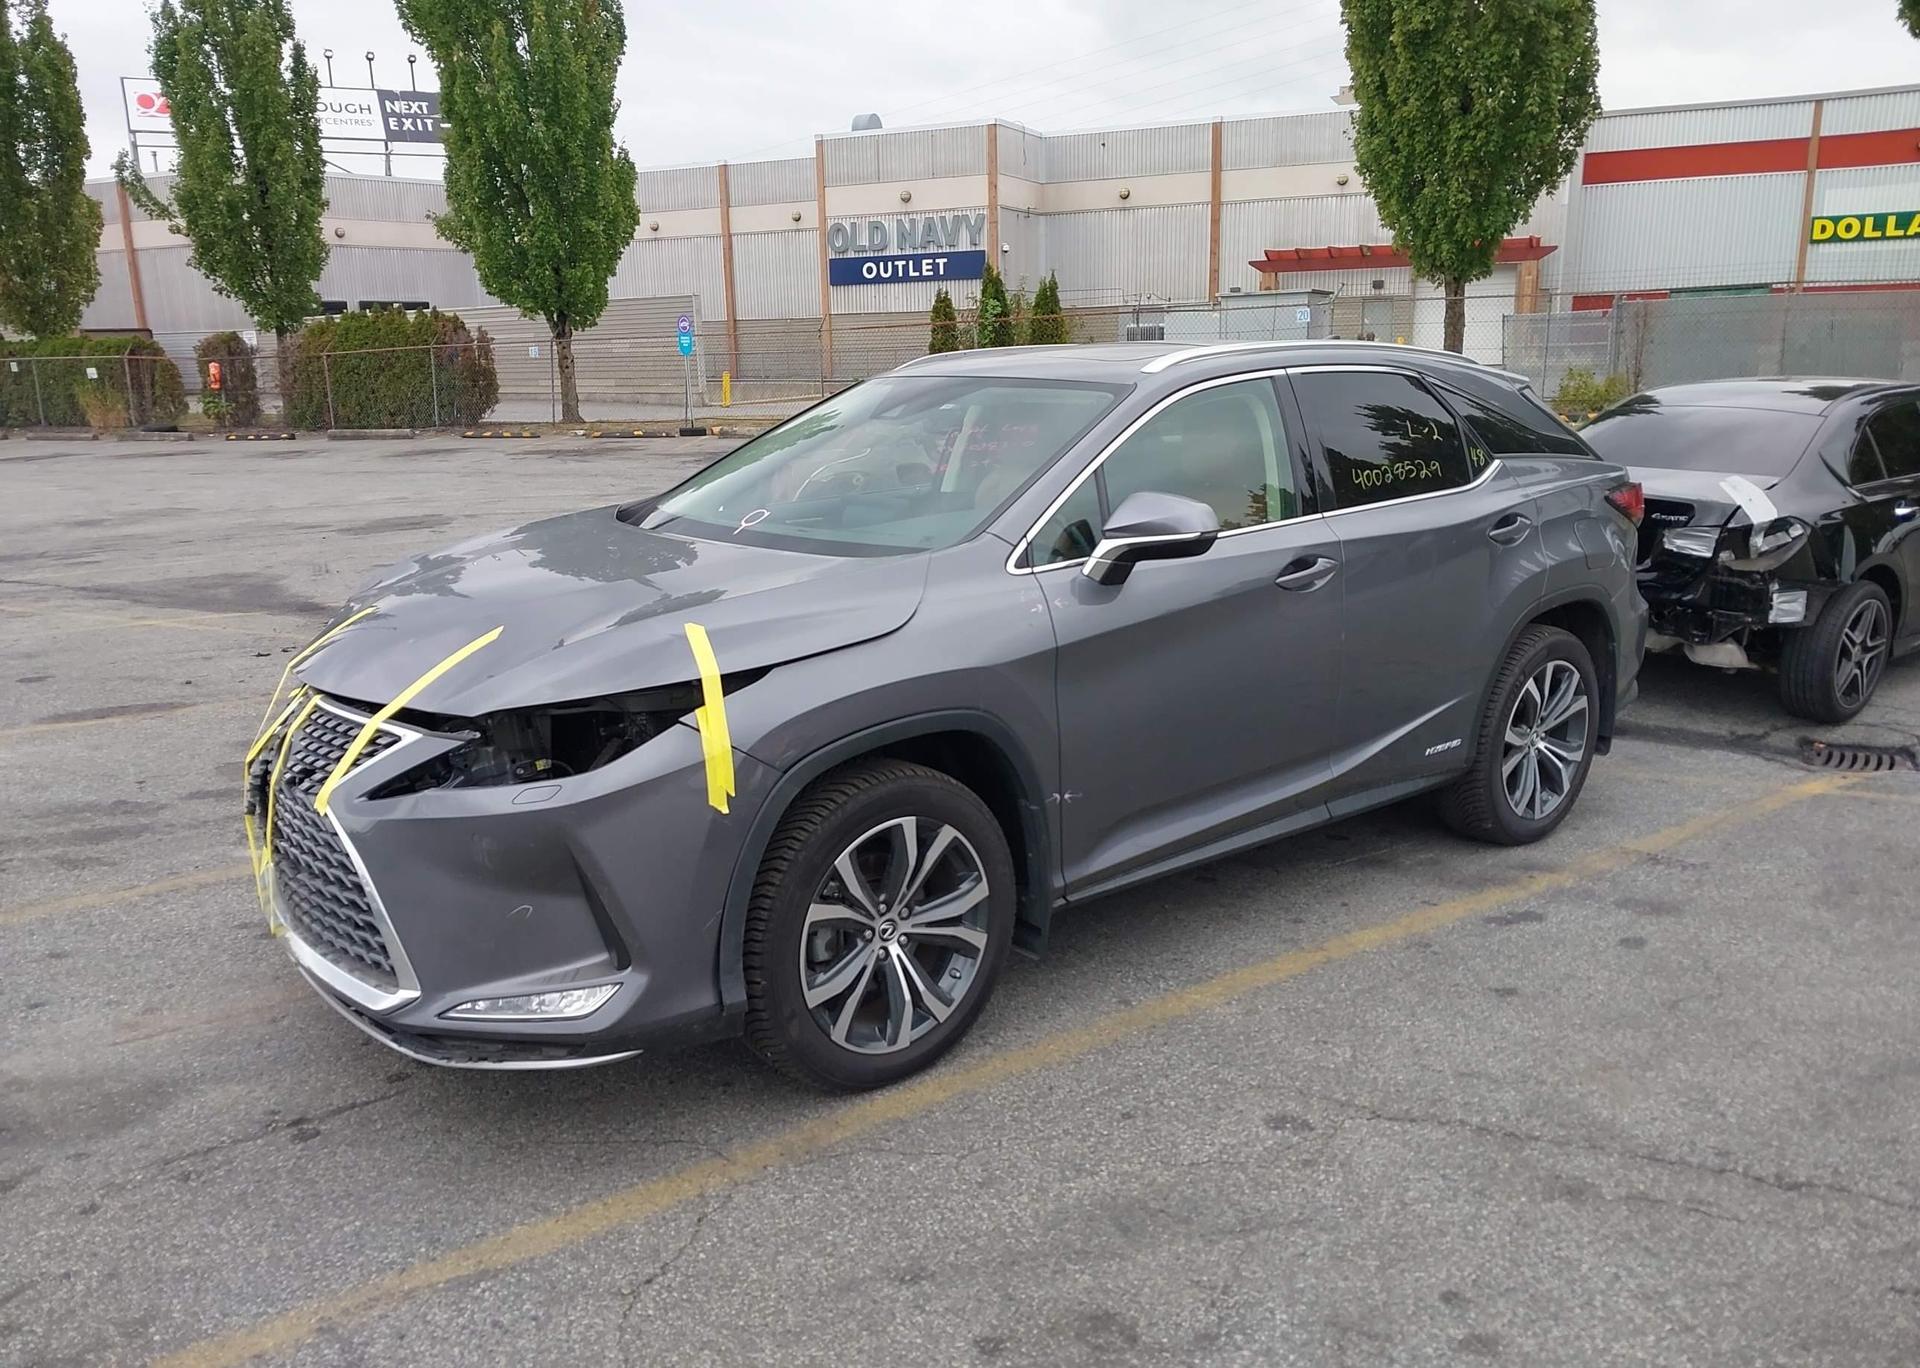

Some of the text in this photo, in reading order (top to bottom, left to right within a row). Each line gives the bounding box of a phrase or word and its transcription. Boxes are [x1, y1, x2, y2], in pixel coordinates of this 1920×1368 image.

[384, 100, 429, 115] NEXT
[388, 117, 434, 131] EXIT
[828, 213, 986, 253] OLD NAVY
[862, 257, 948, 279] OUTLET
[1297, 310, 1309, 321] 20
